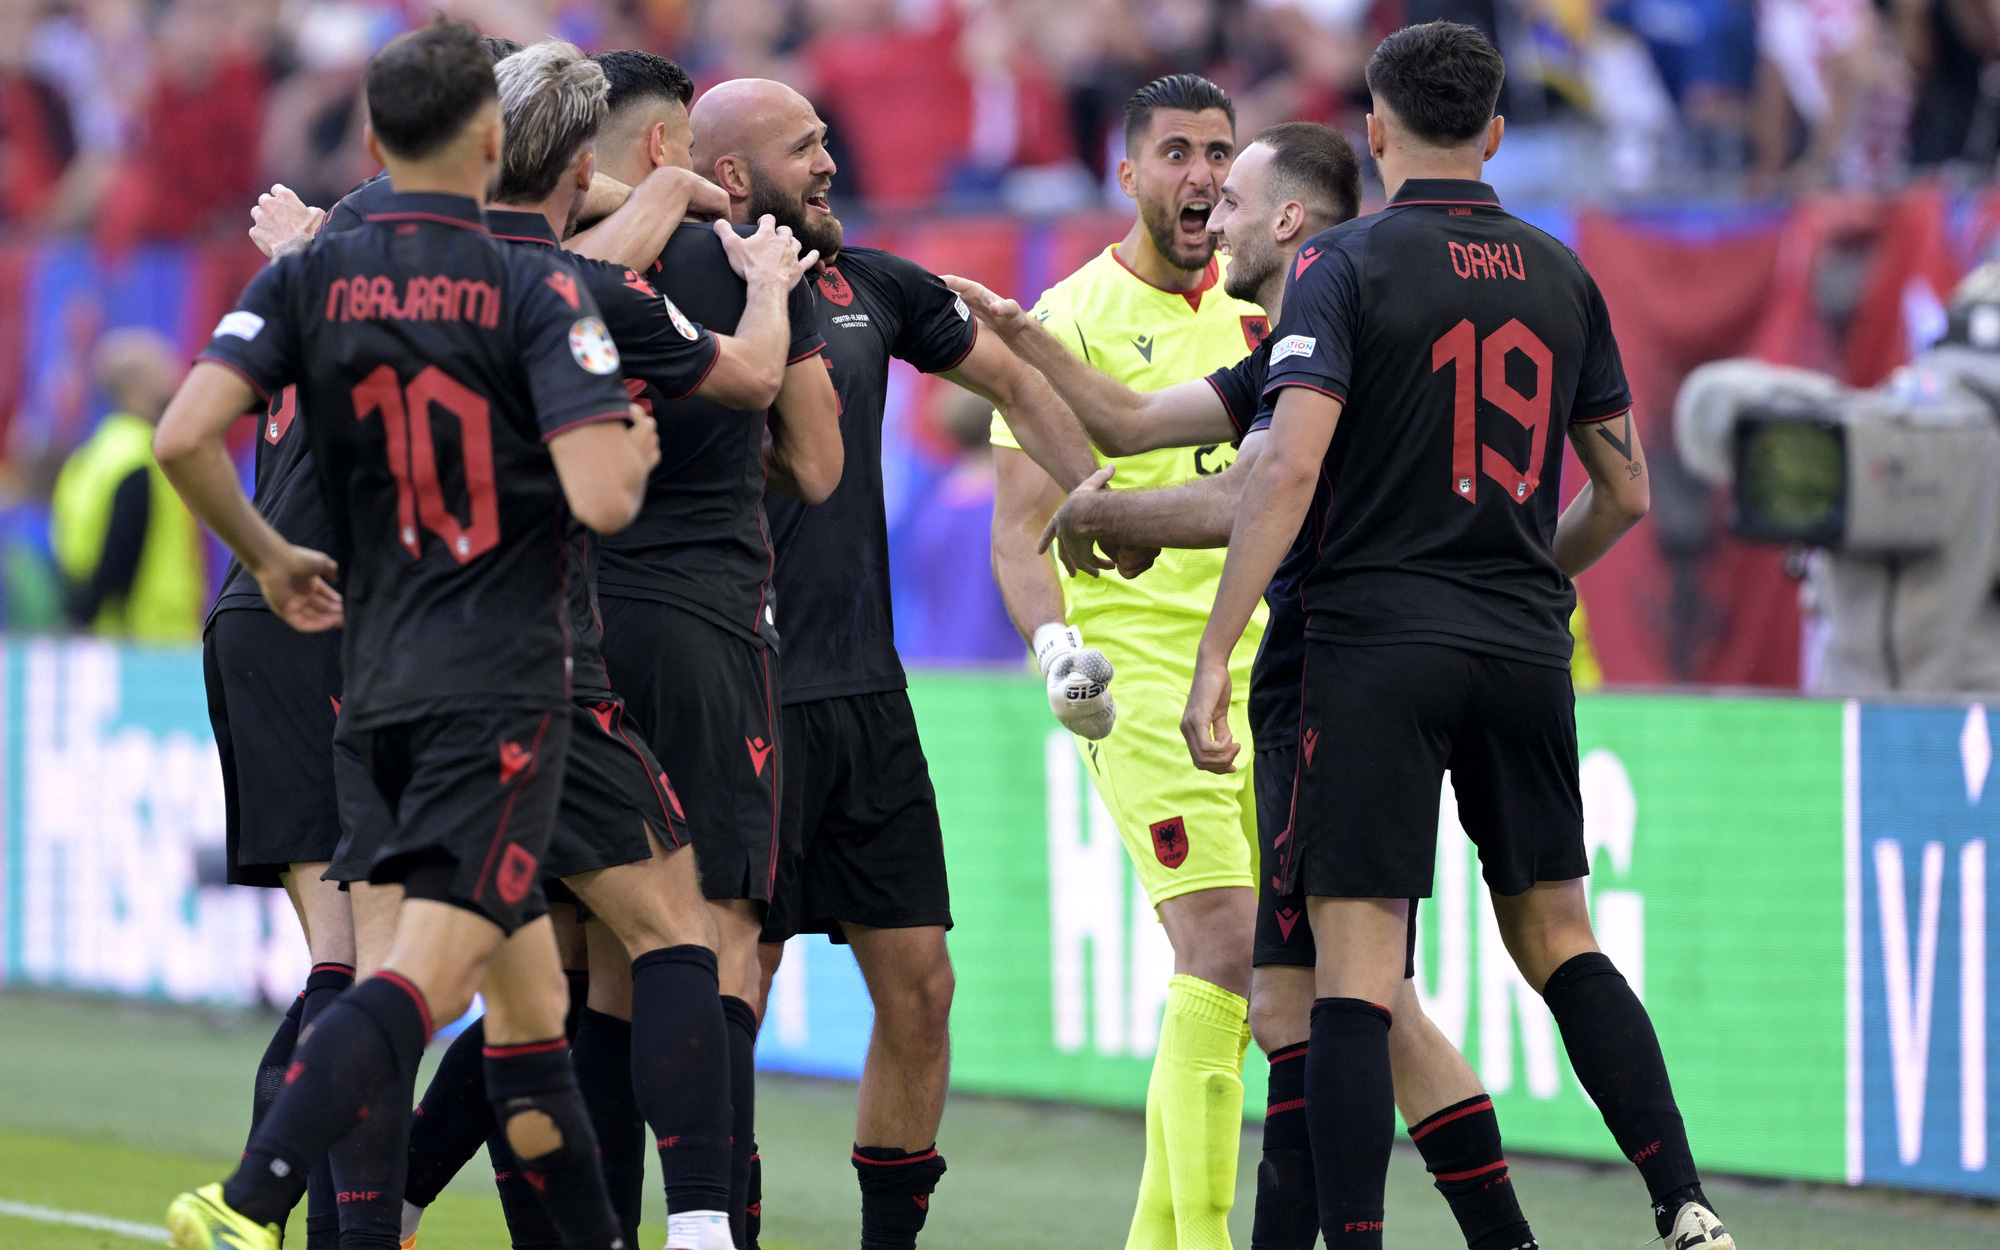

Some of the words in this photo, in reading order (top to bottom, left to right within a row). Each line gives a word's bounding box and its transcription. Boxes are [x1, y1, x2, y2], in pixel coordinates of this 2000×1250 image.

[1448, 207, 1473, 216] ALBANIA
[1447, 241, 1527, 281] DAKU
[831, 292, 850, 300] FSHF
[1431, 317, 1554, 505] 19
[351, 363, 500, 566] 10
[1163, 851, 1183, 862] FSHF
